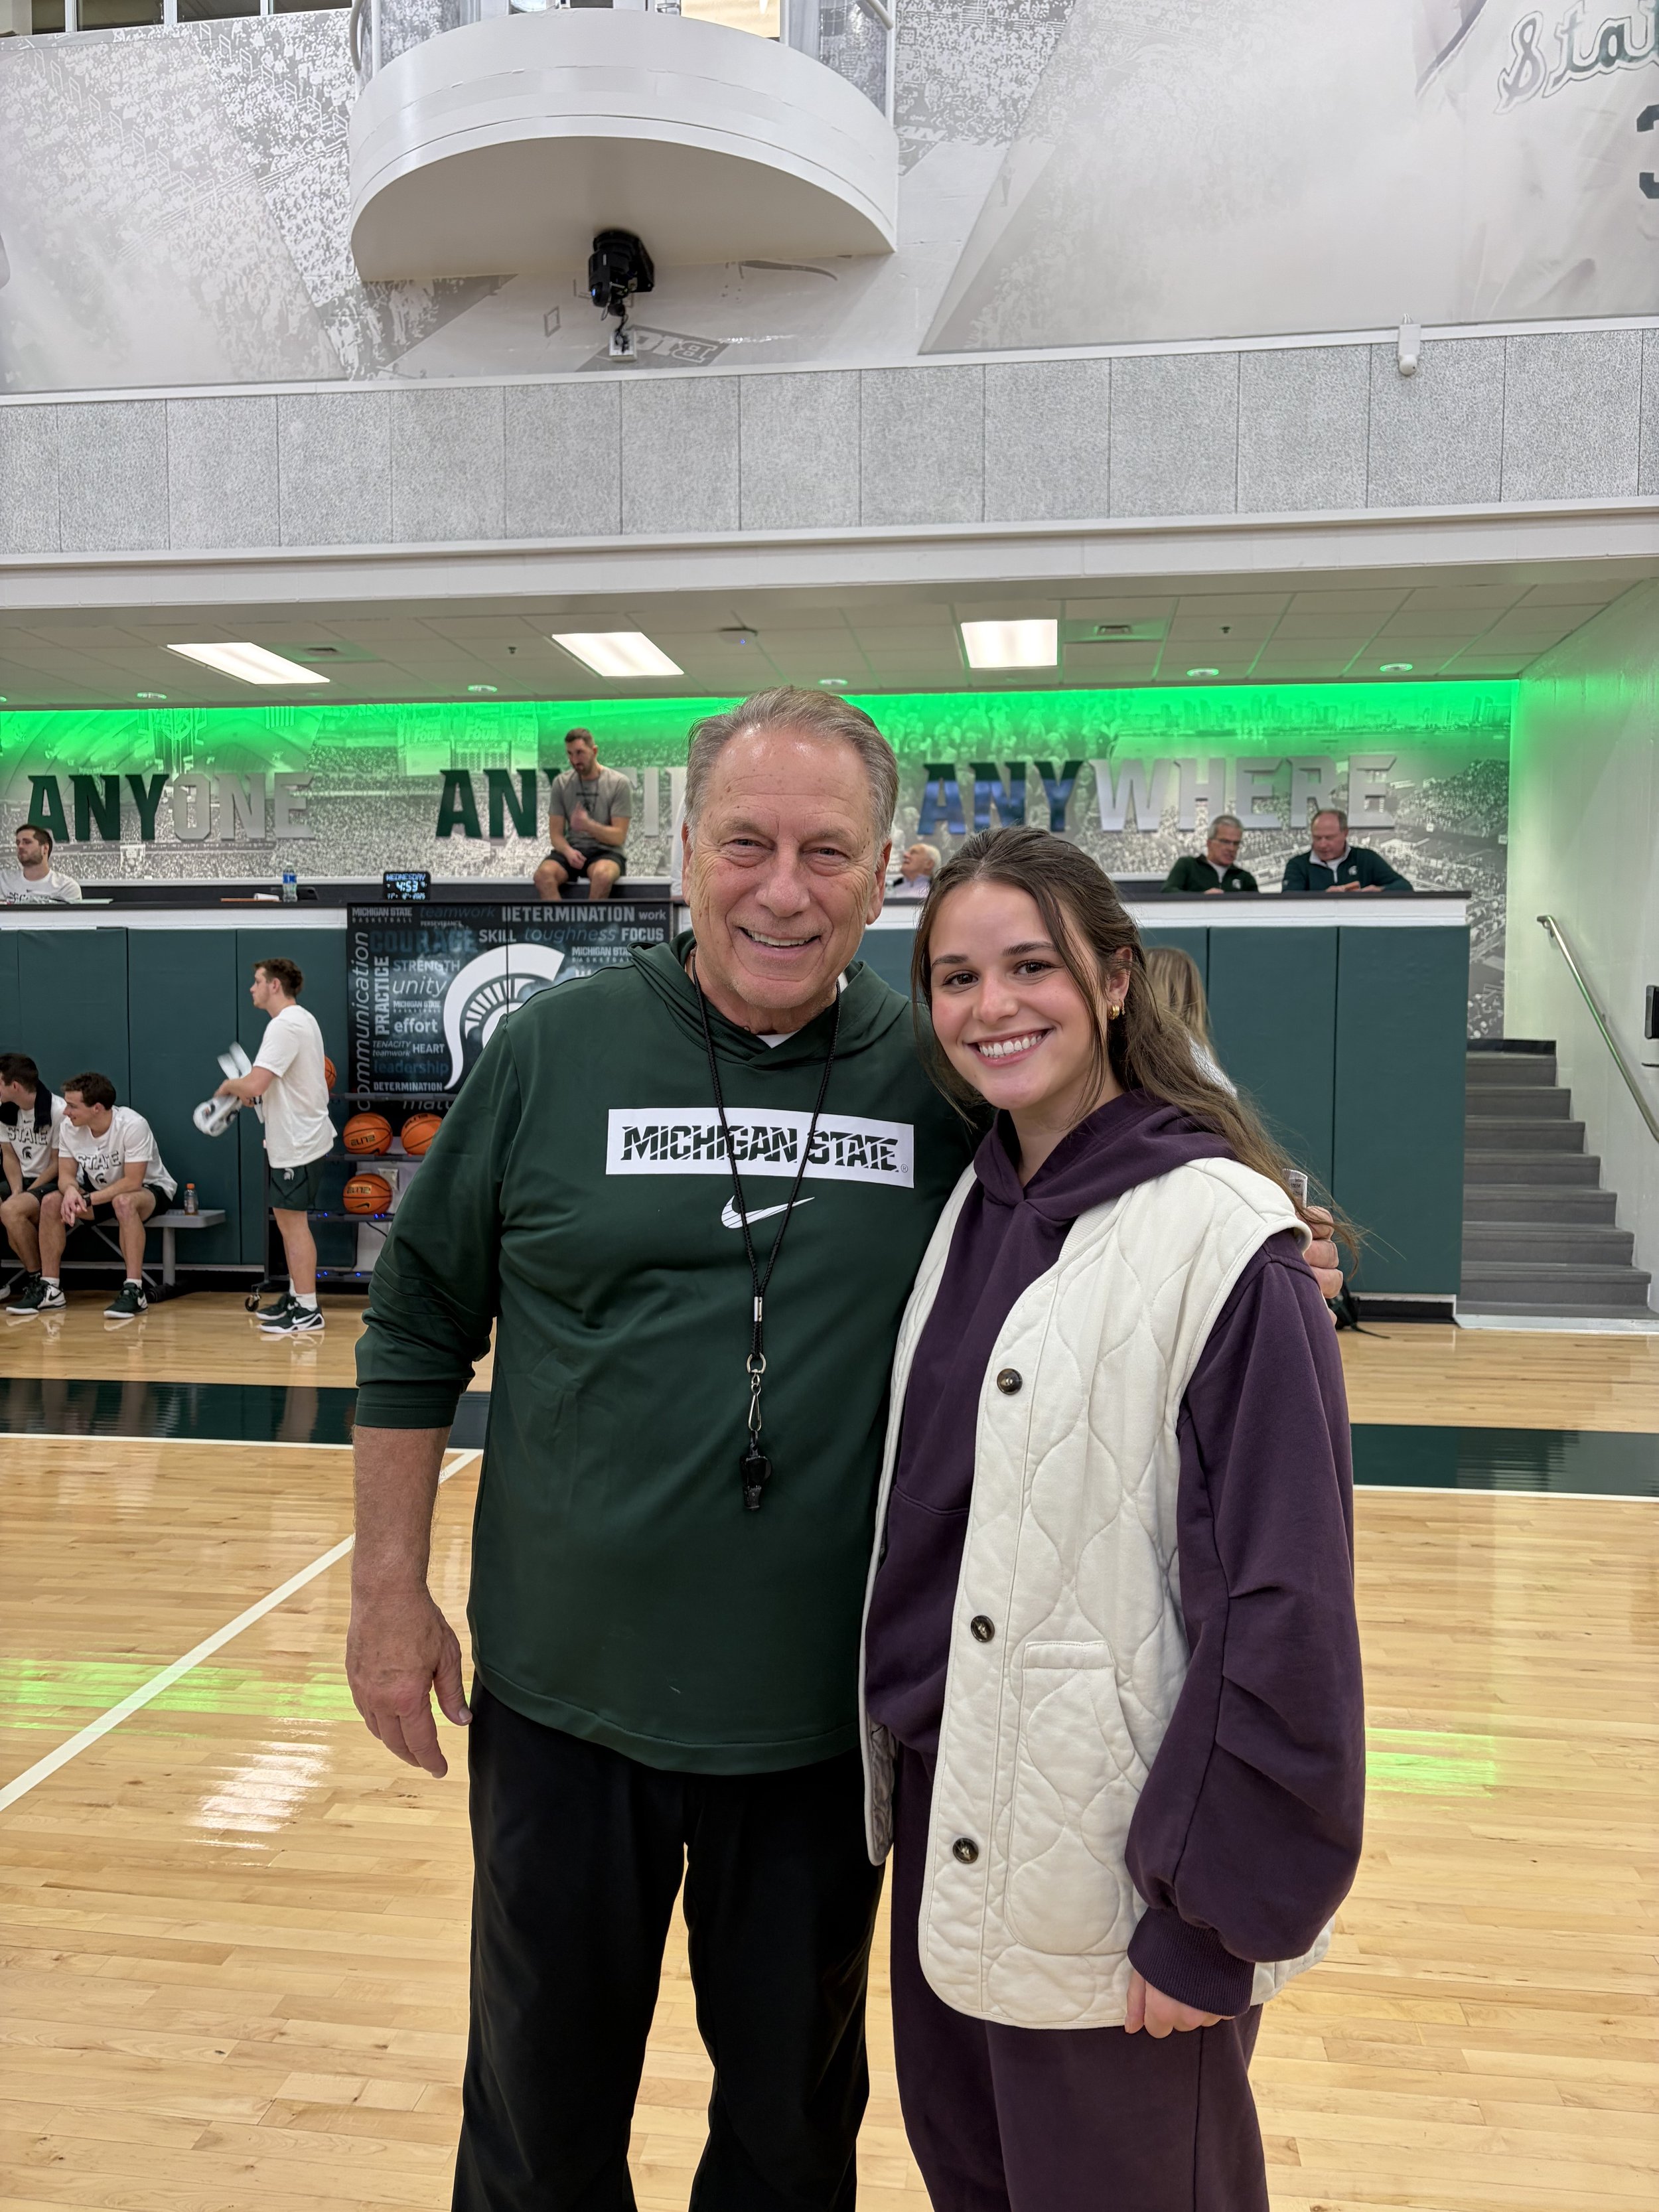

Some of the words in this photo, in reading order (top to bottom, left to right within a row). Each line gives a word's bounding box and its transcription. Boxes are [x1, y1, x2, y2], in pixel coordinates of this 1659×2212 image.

[917, 755, 1397, 834] ANYWHERE
[27, 773, 315, 843] ANYONE
[396, 881, 419, 893] 4:53
[352, 907, 390, 917] MICHIGAN
[390, 907, 412, 917] STATE
[419, 905, 496, 919] teamwork
[502, 907, 635, 922] DETERMINATION
[638, 909, 666, 921] work
[370, 929, 478, 952] COURAGE
[479, 929, 516, 942] SKILL
[525, 926, 616, 943] toughness
[621, 927, 664, 942] FOCUS
[572, 946, 611, 956] MICHIGAN
[393, 960, 460, 972] STRENGTH
[392, 976, 447, 998] unity
[374, 956, 390, 1036] PRACTICE
[394, 1017, 439, 1033] effort
[372, 1040, 411, 1049] TENACITY
[412, 1043, 445, 1054] HEART
[374, 1061, 449, 1076] leadership
[373, 1082, 443, 1092] DETERMINATION
[620, 1126, 798, 1163] MICHIGAN
[807, 1130, 899, 1173] STATE
